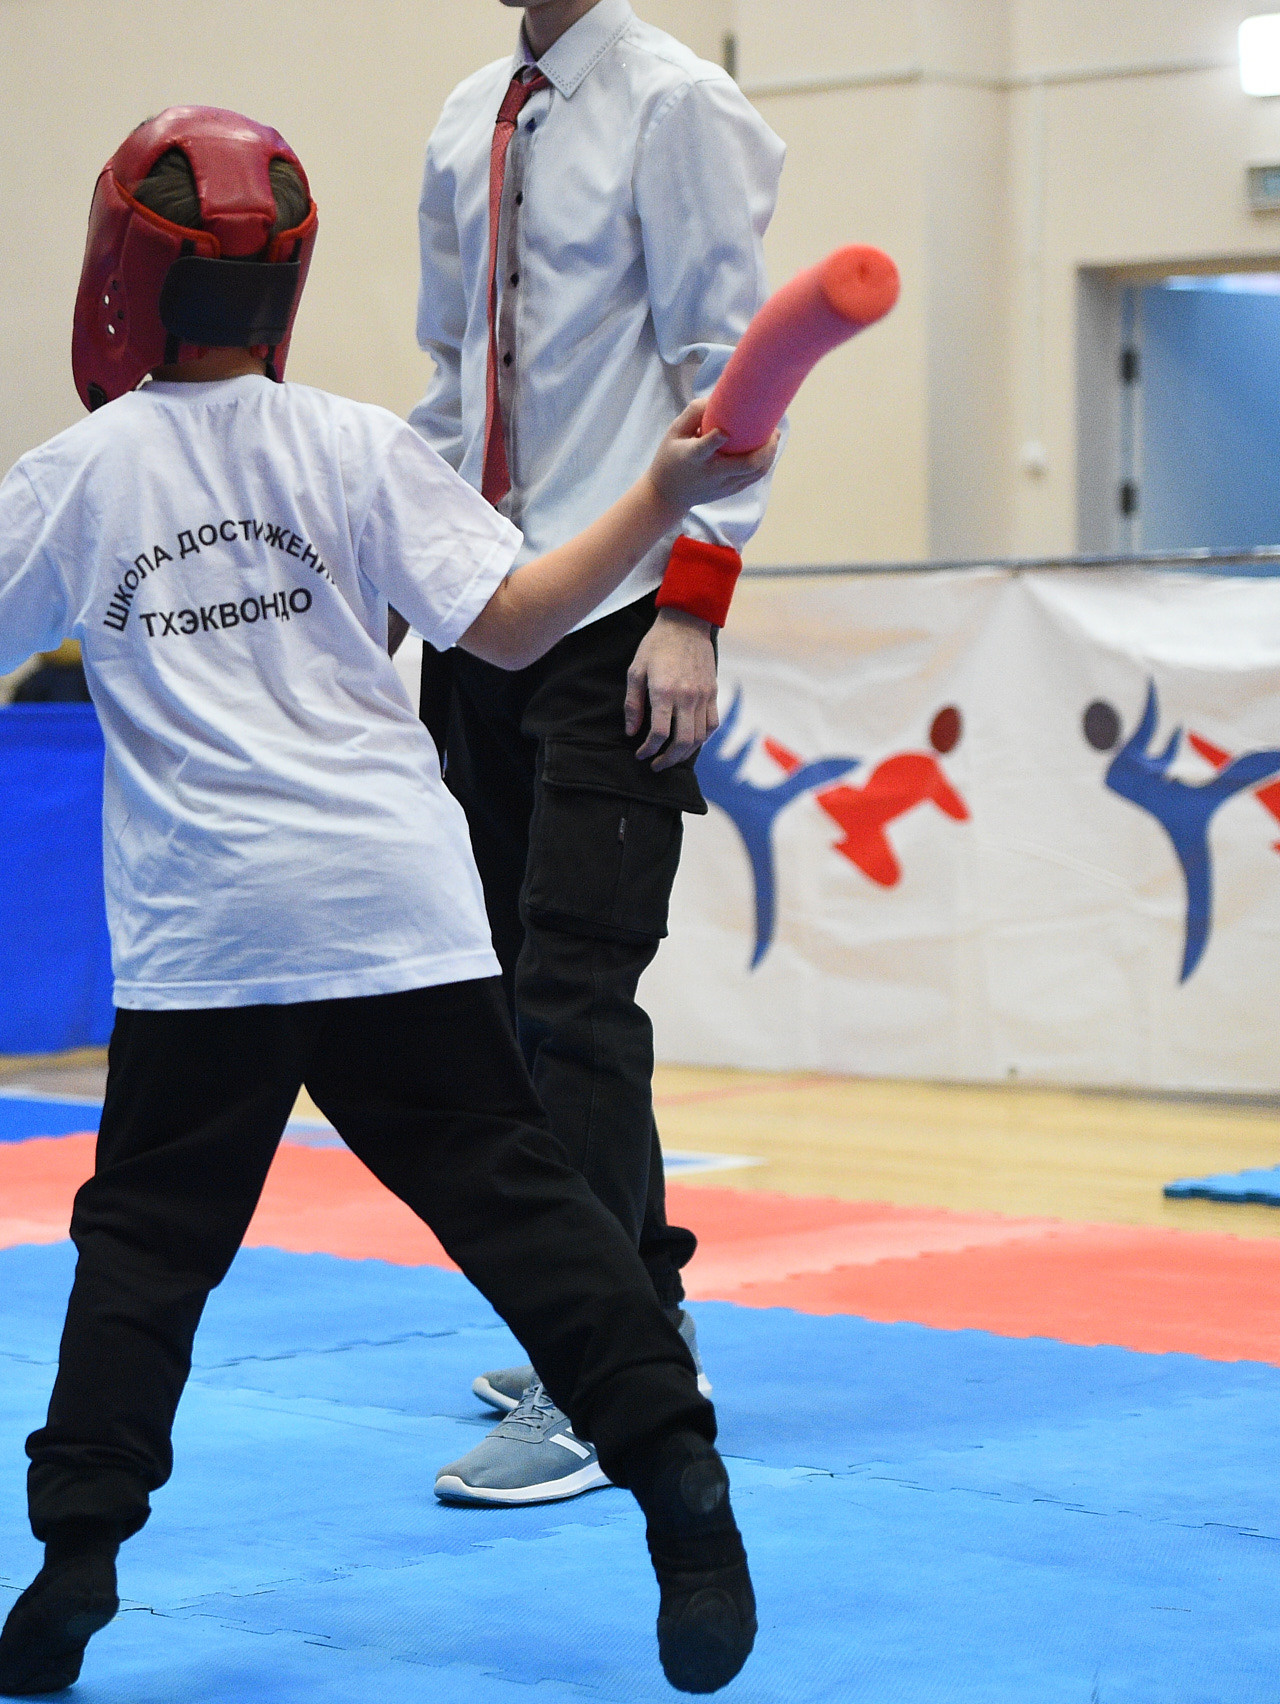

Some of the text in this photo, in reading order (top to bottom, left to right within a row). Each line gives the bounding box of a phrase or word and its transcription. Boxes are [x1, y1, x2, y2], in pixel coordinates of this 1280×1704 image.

[103, 519, 335, 632] ШКОЛА ДОСТИЖЕН
[140, 588, 313, 637] ТХЭКВОНДО
